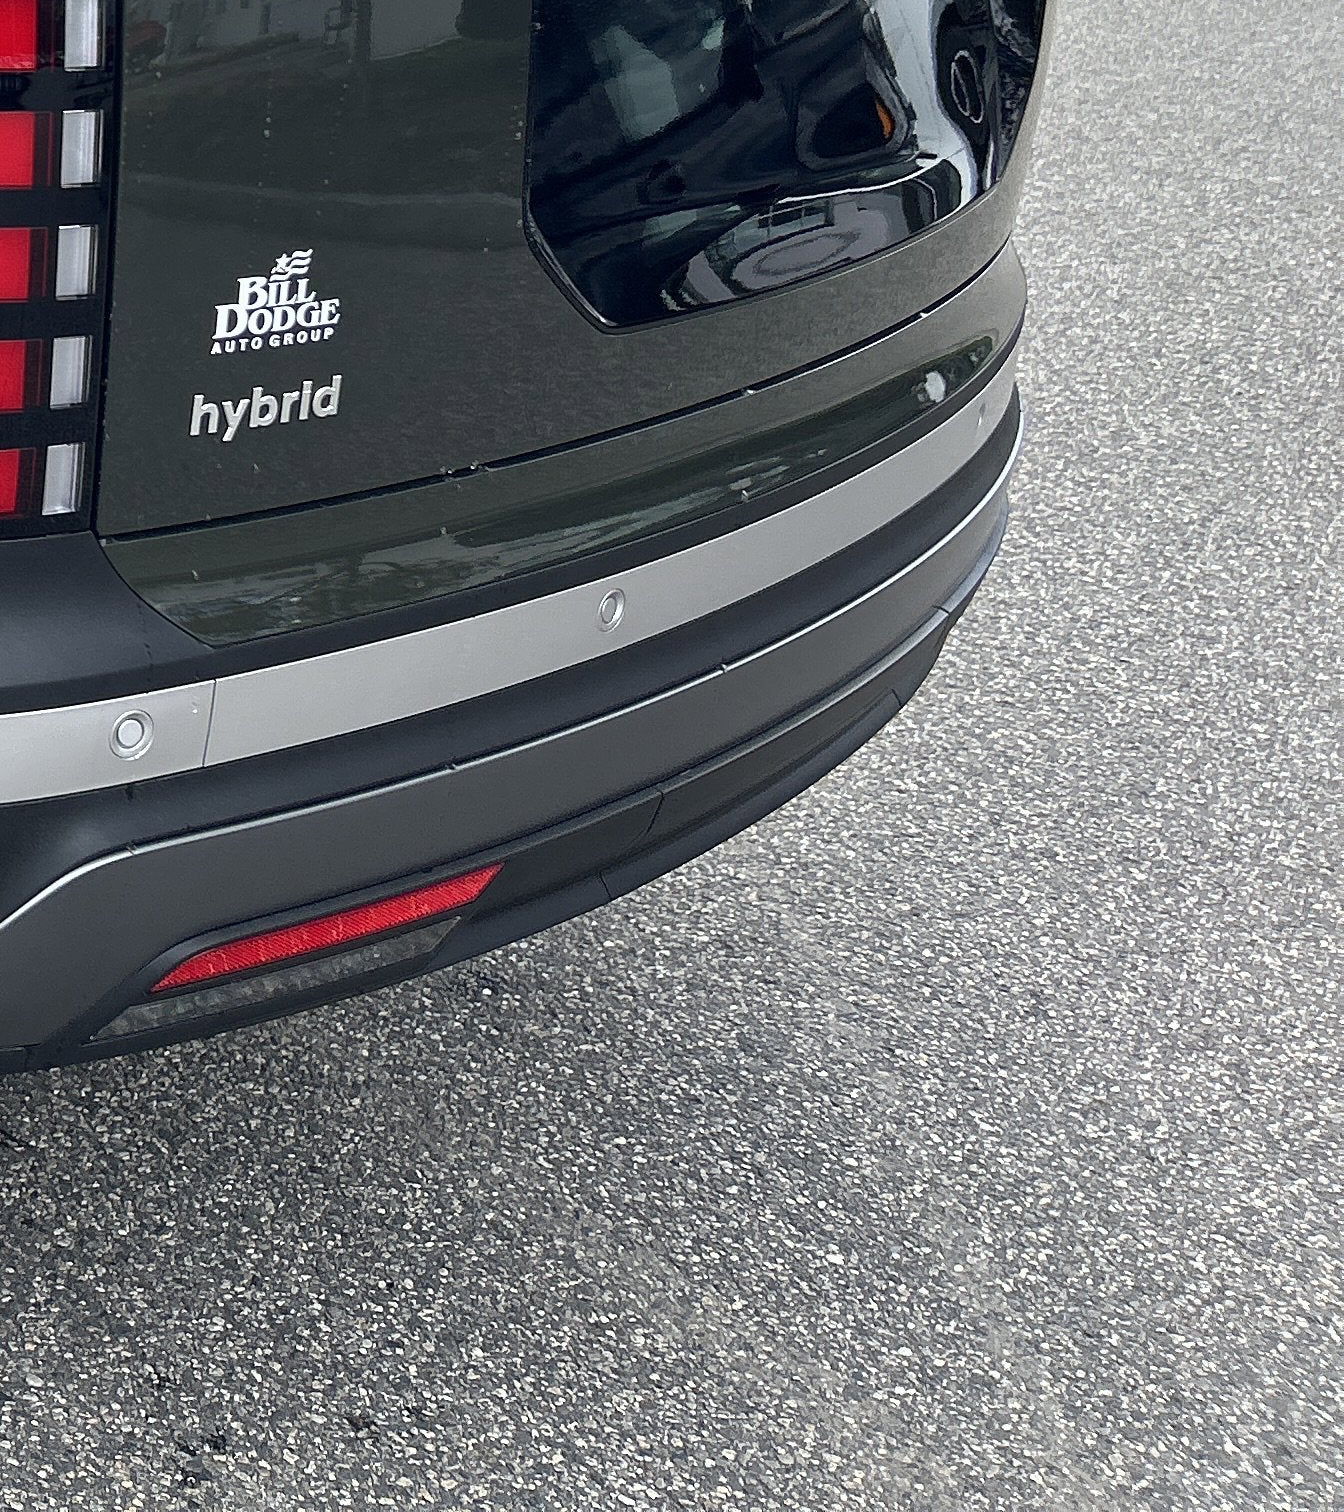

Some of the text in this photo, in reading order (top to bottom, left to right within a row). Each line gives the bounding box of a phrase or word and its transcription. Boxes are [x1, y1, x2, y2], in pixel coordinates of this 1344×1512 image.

[237, 276, 317, 310] BILL
[211, 298, 341, 340] DODGE
[210, 327, 334, 355] AUTO GROUP
[189, 374, 342, 442] hybrid
